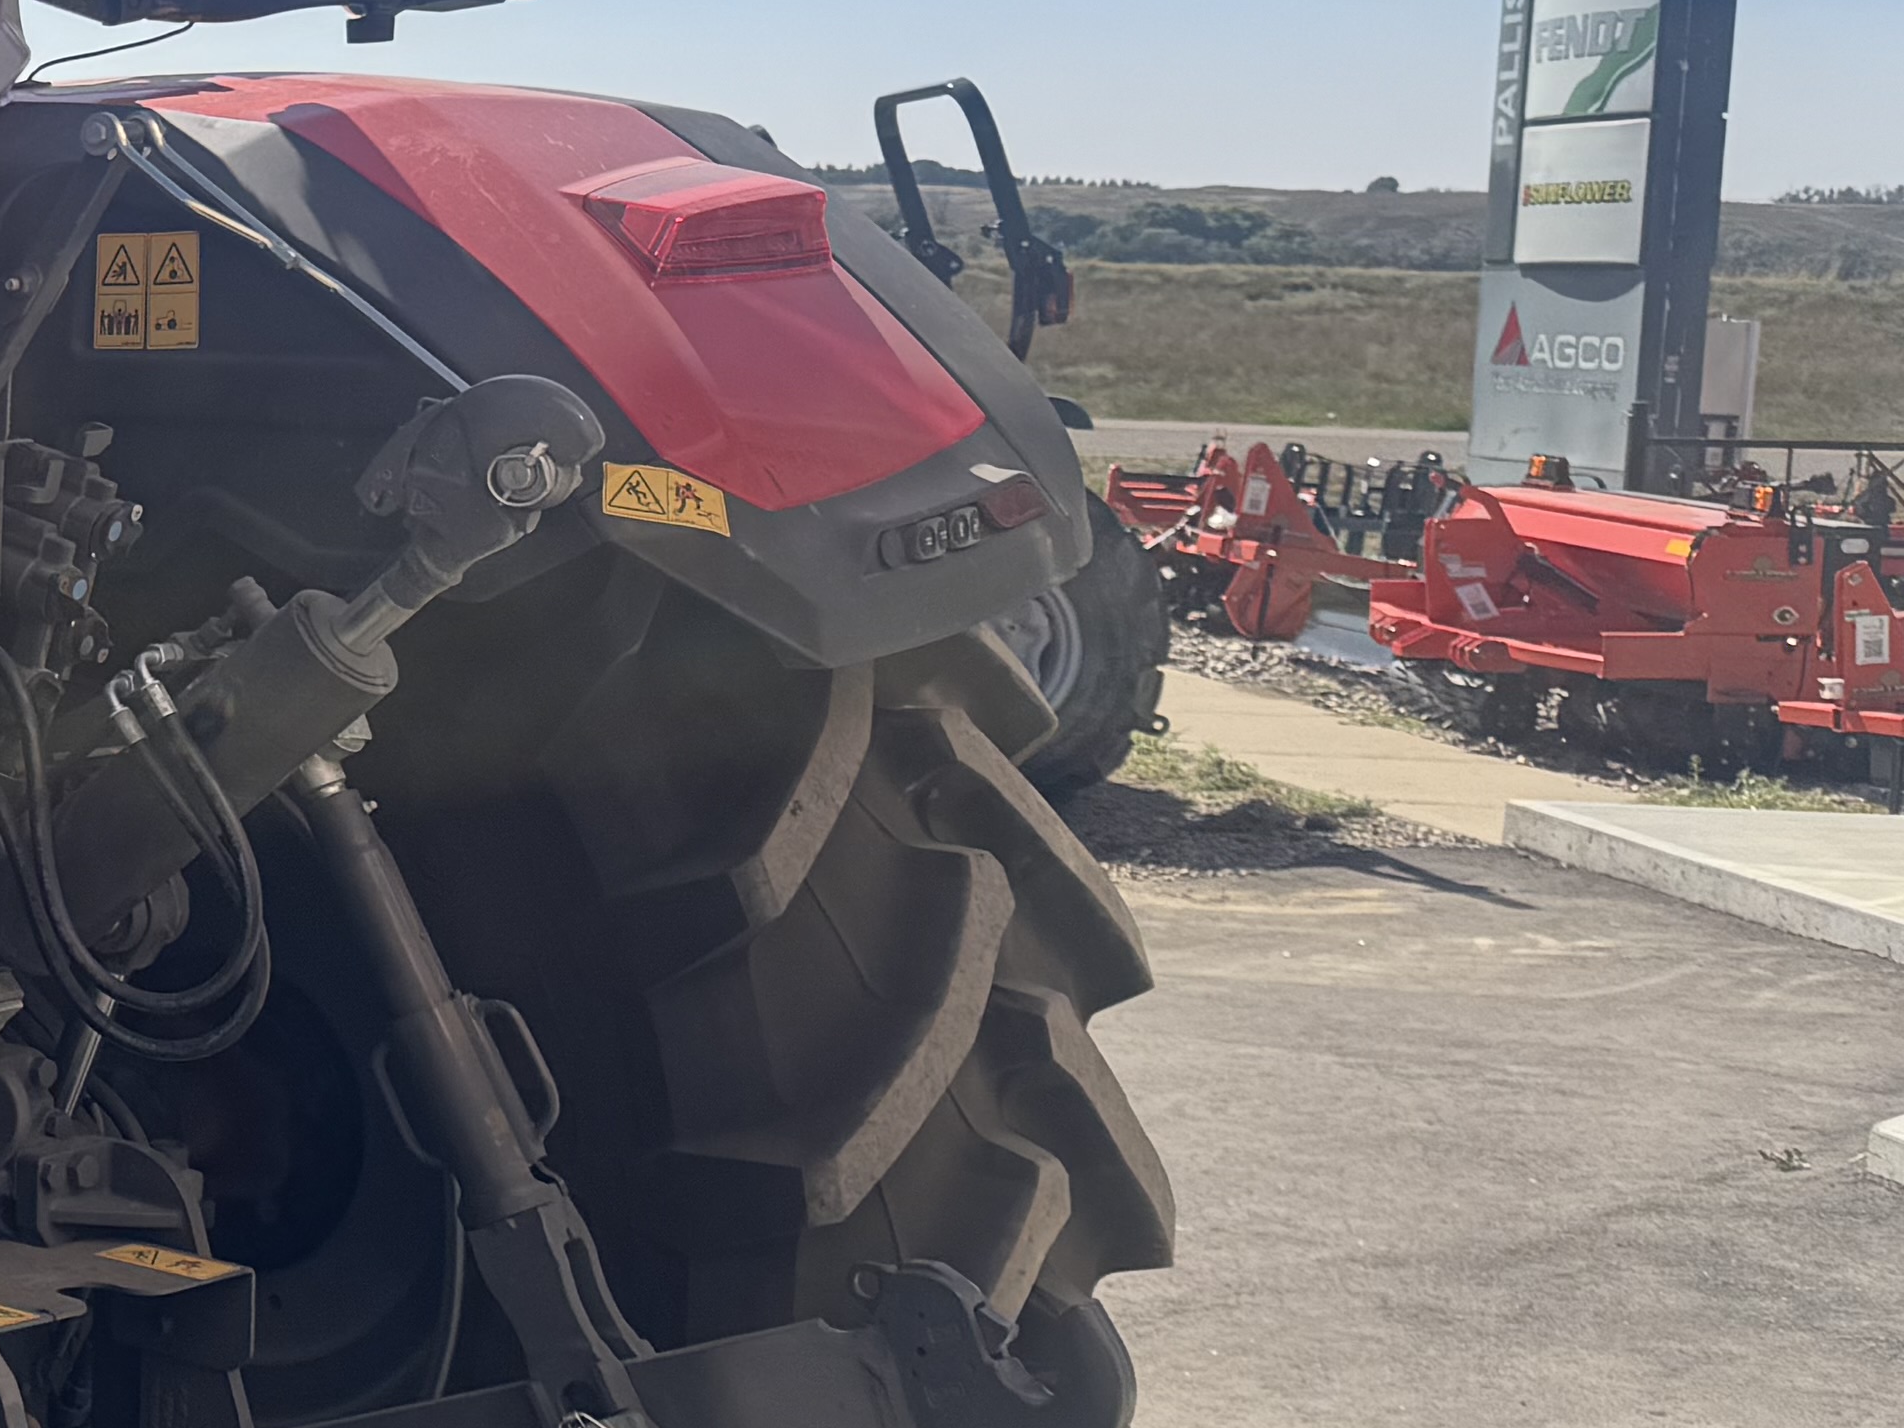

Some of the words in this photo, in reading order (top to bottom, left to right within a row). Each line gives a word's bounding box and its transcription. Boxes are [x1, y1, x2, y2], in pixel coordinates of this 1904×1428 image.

[1535, 6, 1652, 63] FENDT
[1529, 179, 1632, 206] SUNFLOWER
[1530, 333, 1625, 371] AGCO
